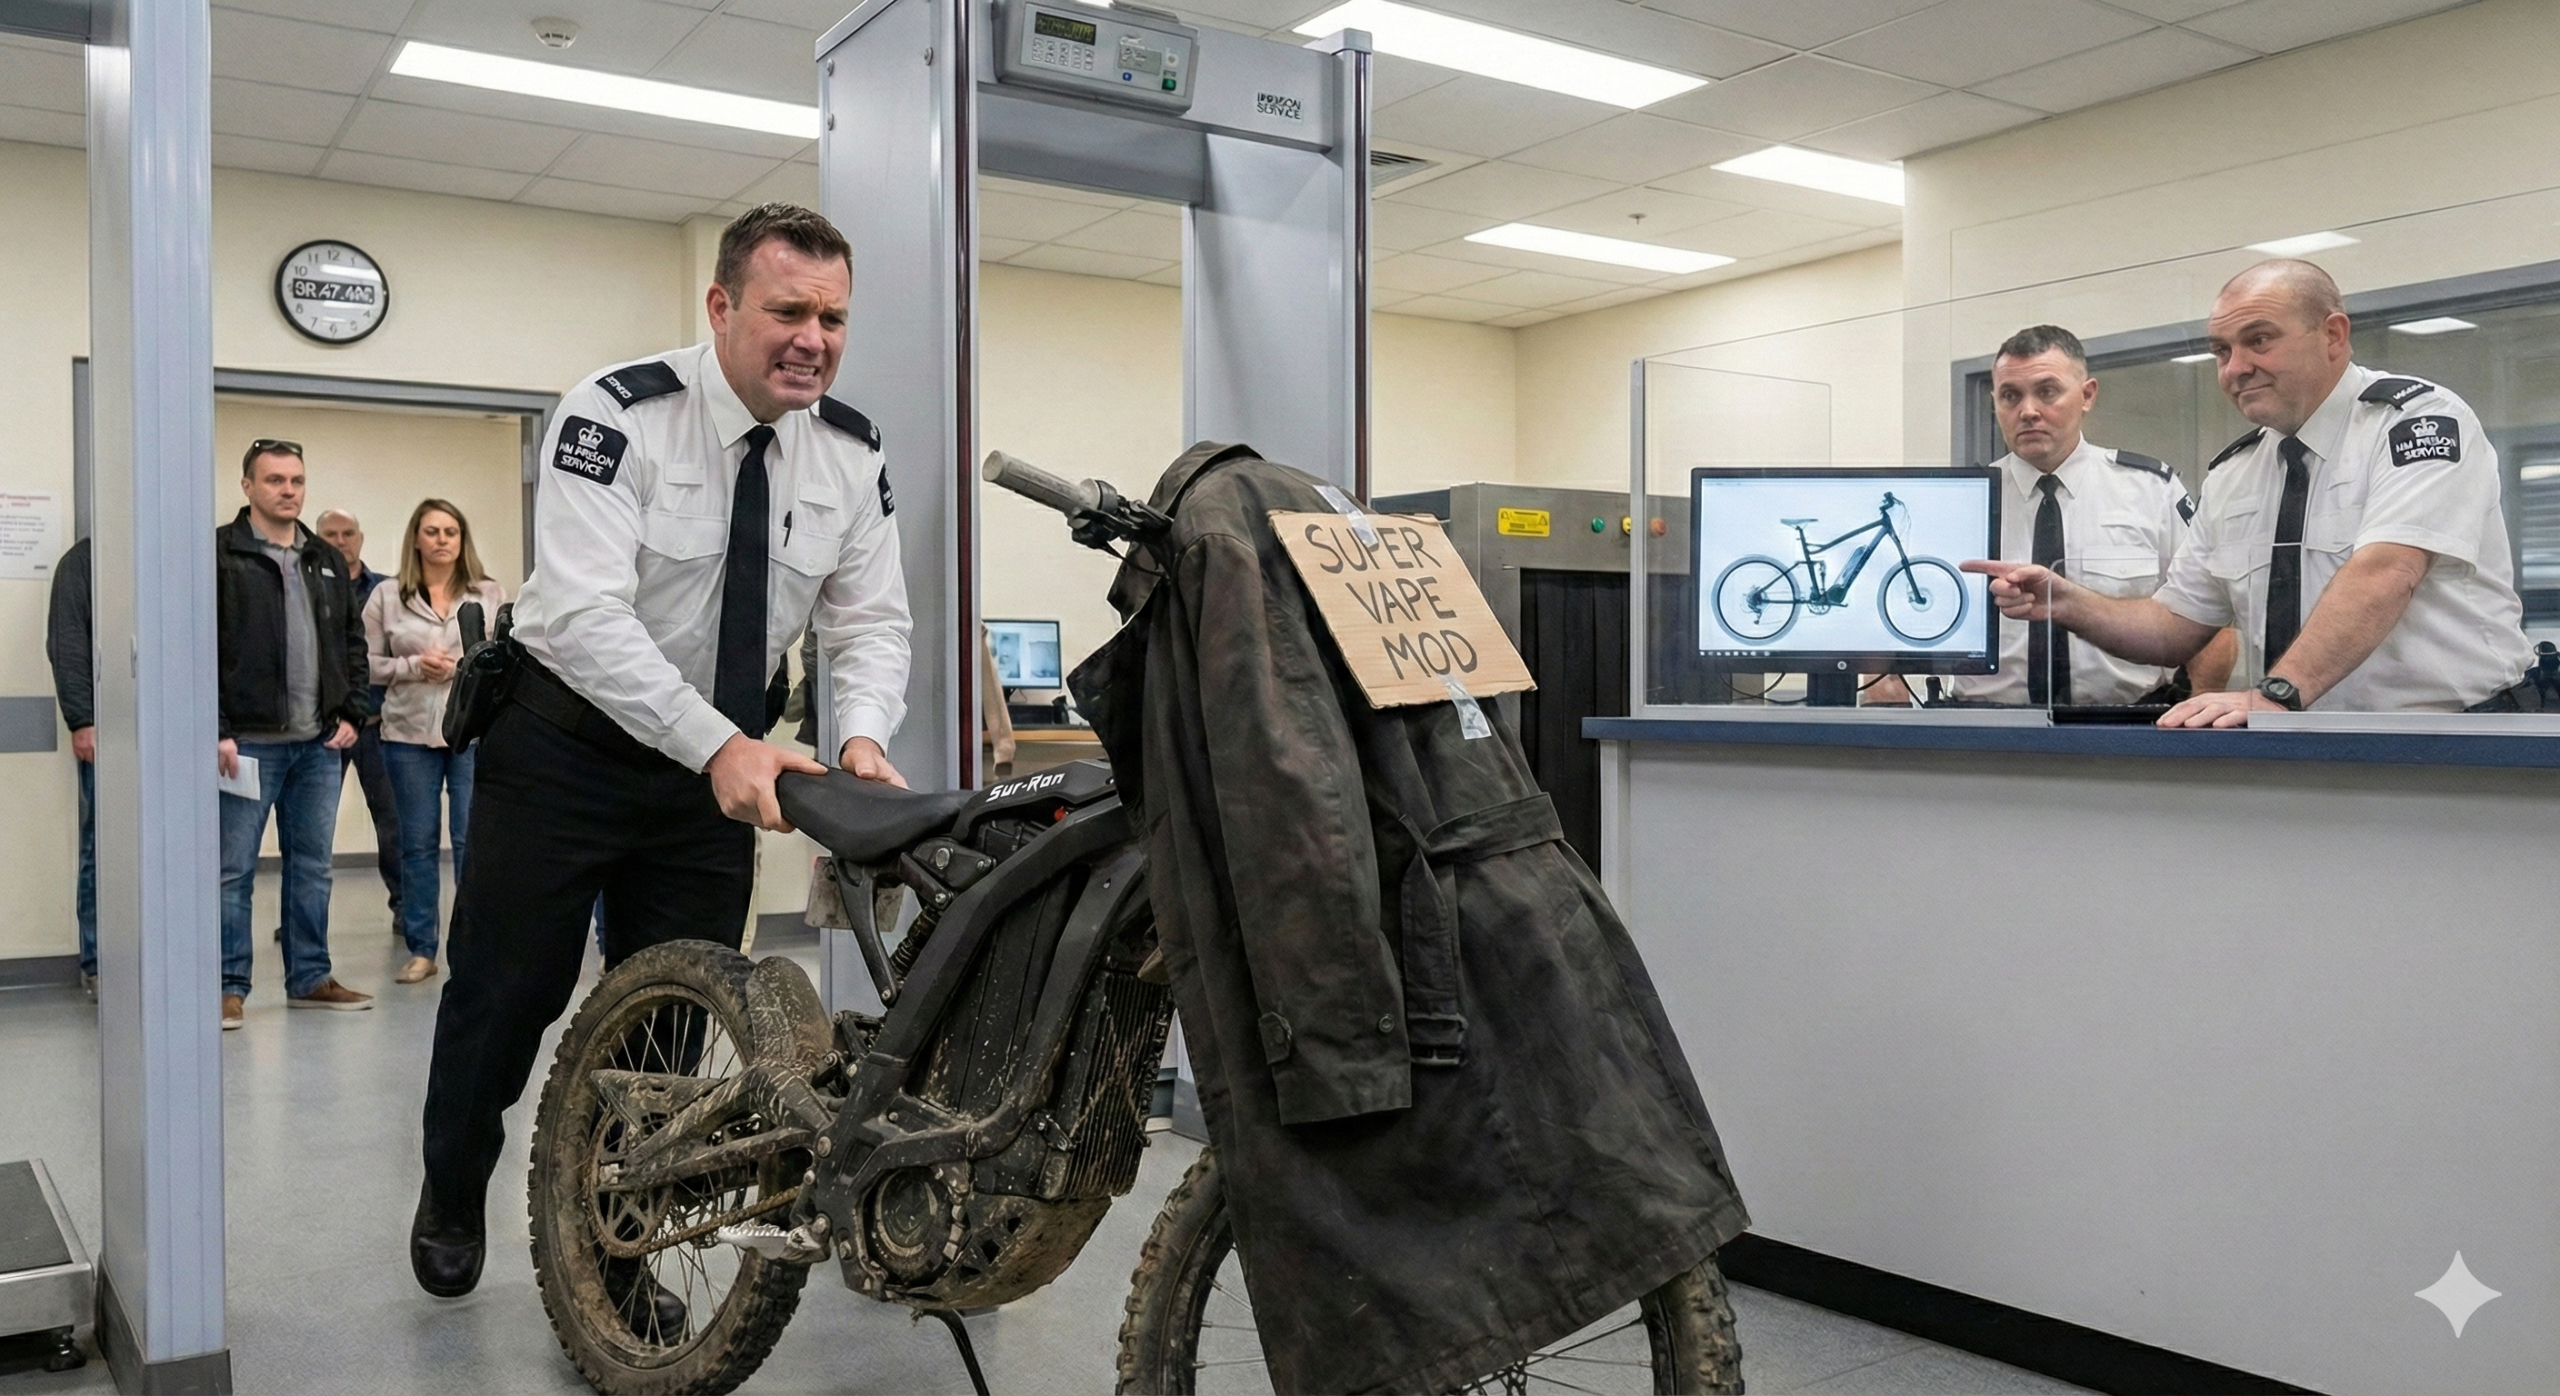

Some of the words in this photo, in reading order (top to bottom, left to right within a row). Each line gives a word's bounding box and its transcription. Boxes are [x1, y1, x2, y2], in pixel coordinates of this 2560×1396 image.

[308, 252, 318, 264] 11
[327, 249, 340, 261] 12
[294, 265, 308, 277] 10
[311, 316, 318, 330] 7
[1304, 523, 1442, 574] SUPER
[1345, 576, 1457, 624] VAPE
[1381, 630, 1478, 681] MOD
[985, 773, 1066, 803] Sur-Ron
